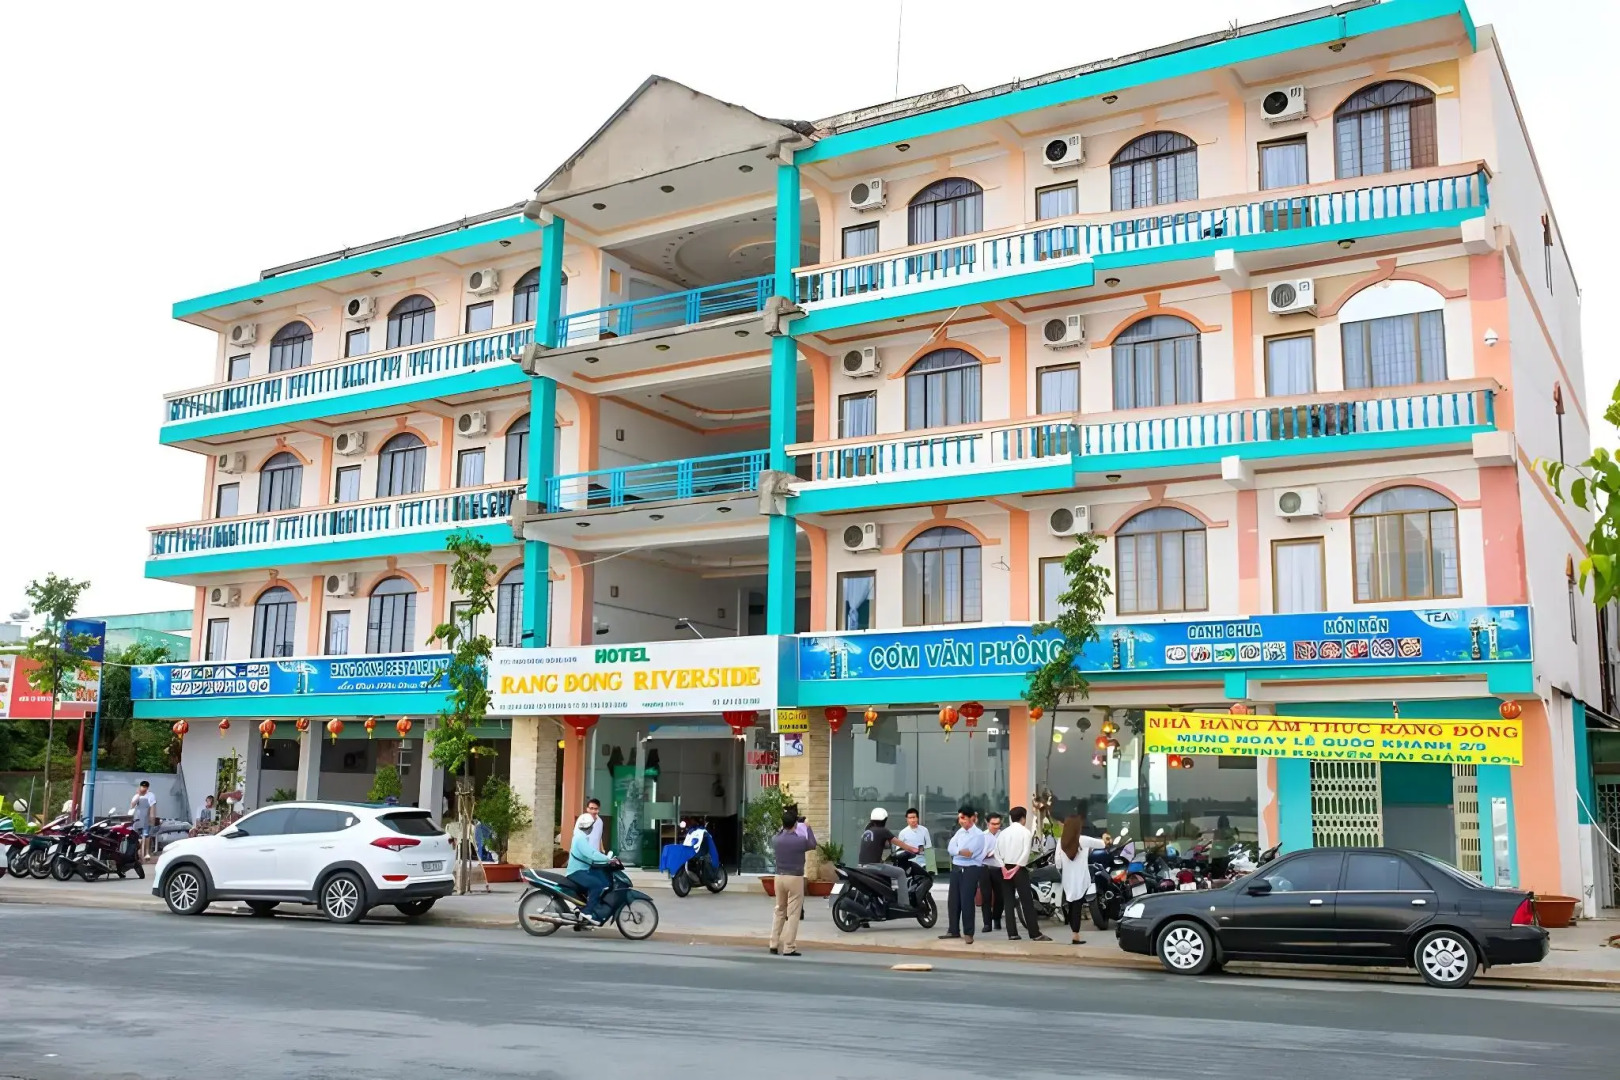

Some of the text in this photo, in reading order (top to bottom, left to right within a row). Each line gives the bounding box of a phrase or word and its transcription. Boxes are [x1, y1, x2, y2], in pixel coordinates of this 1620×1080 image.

[595, 647, 650, 663] HOTEL
[869, 641, 919, 670] CƠM
[925, 638, 974, 667] VĂN
[501, 673, 559, 695] RANG
[633, 666, 761, 691] RIVERSIDE
